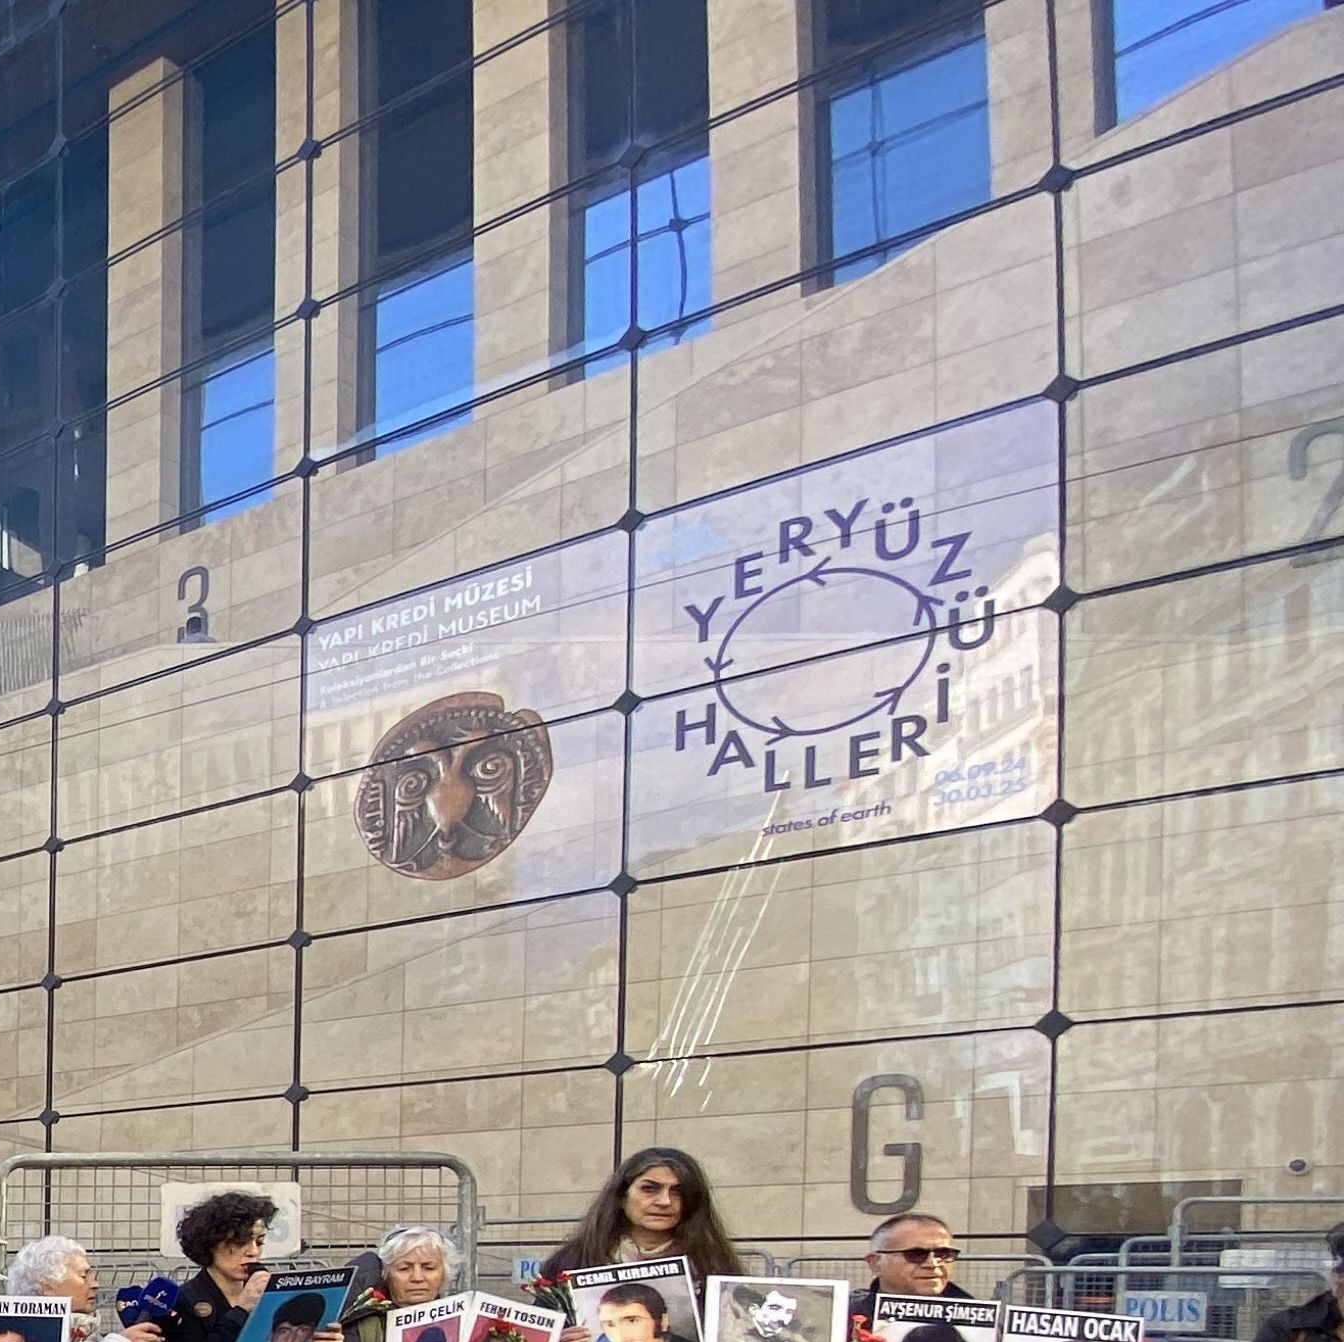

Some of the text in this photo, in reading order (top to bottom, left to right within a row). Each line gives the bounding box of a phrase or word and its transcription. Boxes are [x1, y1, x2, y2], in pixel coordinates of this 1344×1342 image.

[684, 497, 995, 651] YERYÜZÜ
[177, 566, 209, 643] 3
[318, 565, 532, 651] YAPI KREDİ MÜZESİ
[318, 595, 540, 674] YAPI KREDİ MUSEUM
[675, 663, 951, 793] HALLERİ
[762, 801, 892, 837] states of earth
[849, 1073, 924, 1215] G
[276, 1274, 345, 1289] ŞİRİN BAYRAM
[14, 1302, 66, 1315] TORAMAN
[395, 1302, 464, 1326] EDİP ÇELİK
[514, 1310, 555, 1328] TOSUN
[880, 1301, 995, 1324] AYŞENUR ŞİMŞEK
[1013, 1312, 1137, 1342] HASAN OCAK
